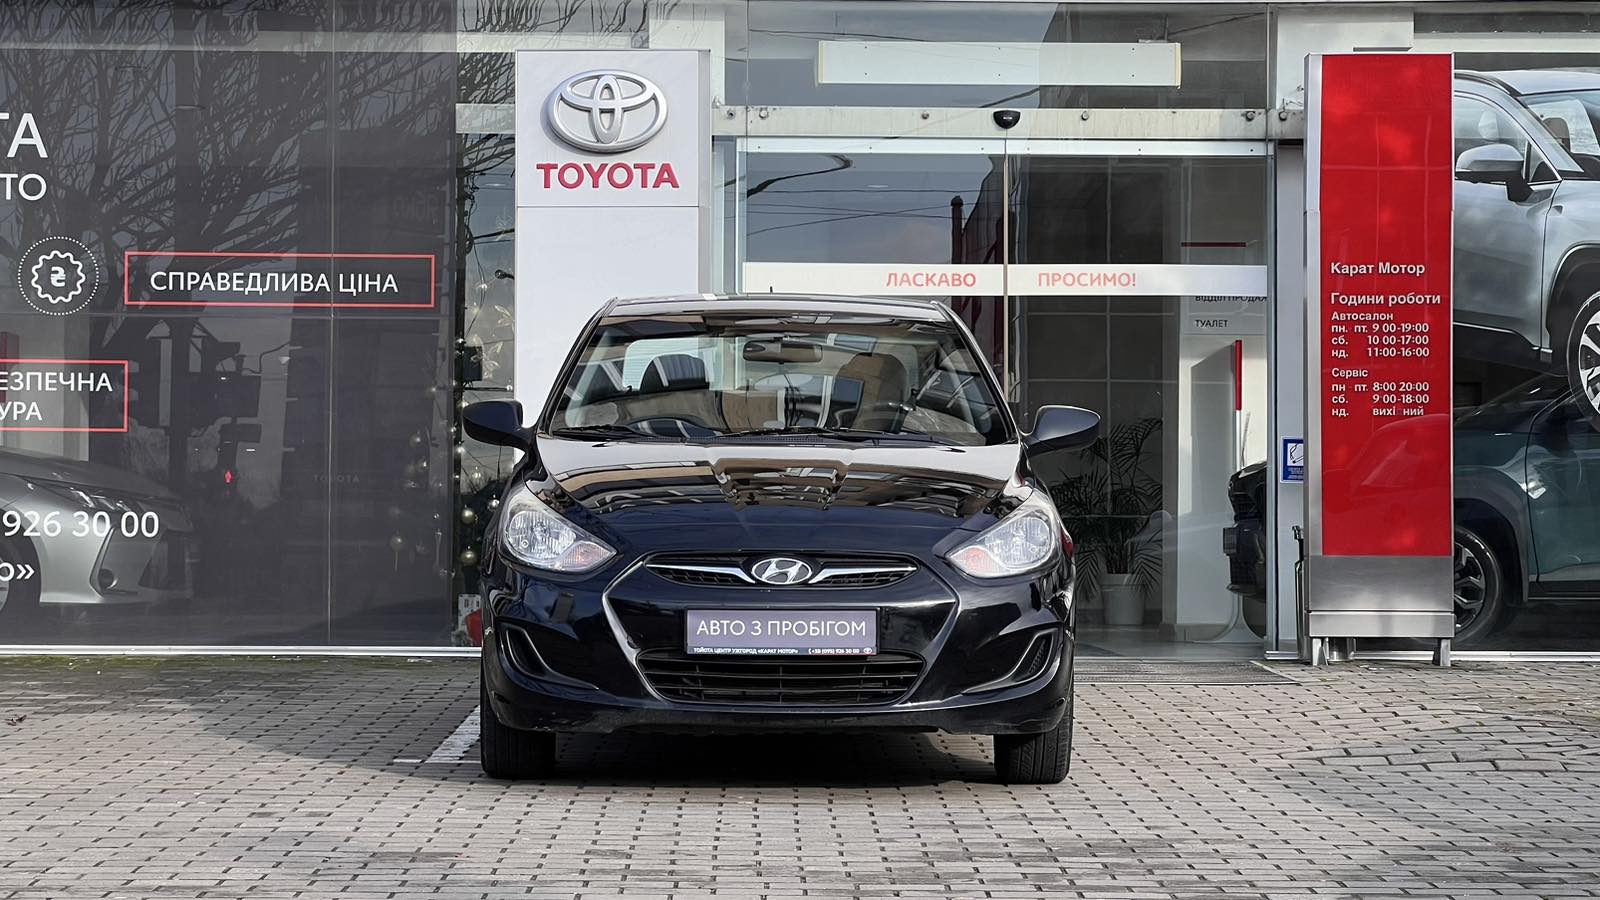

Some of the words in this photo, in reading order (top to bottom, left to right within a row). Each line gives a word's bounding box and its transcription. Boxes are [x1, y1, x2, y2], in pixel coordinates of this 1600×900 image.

[536, 162, 680, 189] TOYOTA
[0, 173, 47, 201] ТО
[1331, 262, 1374, 277] Карат
[1378, 262, 1425, 277] Мотор
[150, 271, 330, 295] СПРАВЕДЛИВА
[339, 273, 399, 296] ЦІНА
[886, 272, 977, 288] ЛАСКАВО
[1038, 271, 1136, 287] ПРОСИМО!
[1331, 292, 1384, 306] Години
[1388, 292, 1441, 307] роботи
[1331, 311, 1394, 321] Автосалон
[1194, 319, 1228, 328] ТУАЛЕТ
[1331, 325, 1348, 333] пн.
[1354, 325, 1368, 333] пт.
[1331, 335, 1348, 345] сб.
[1331, 349, 1349, 358] нд.
[1368, 347, 1430, 357] 11:00-16:00
[1331, 367, 1368, 379] Сервіс
[1331, 394, 1348, 404] сб.
[1331, 408, 1349, 417] нд.
[2, 510, 62, 538] 926
[72, 510, 111, 538] 30
[120, 511, 159, 538] 00
[696, 620, 746, 636] АВТО
[750, 620, 762, 636] З
[767, 620, 866, 637] ПРОБІГОМ
